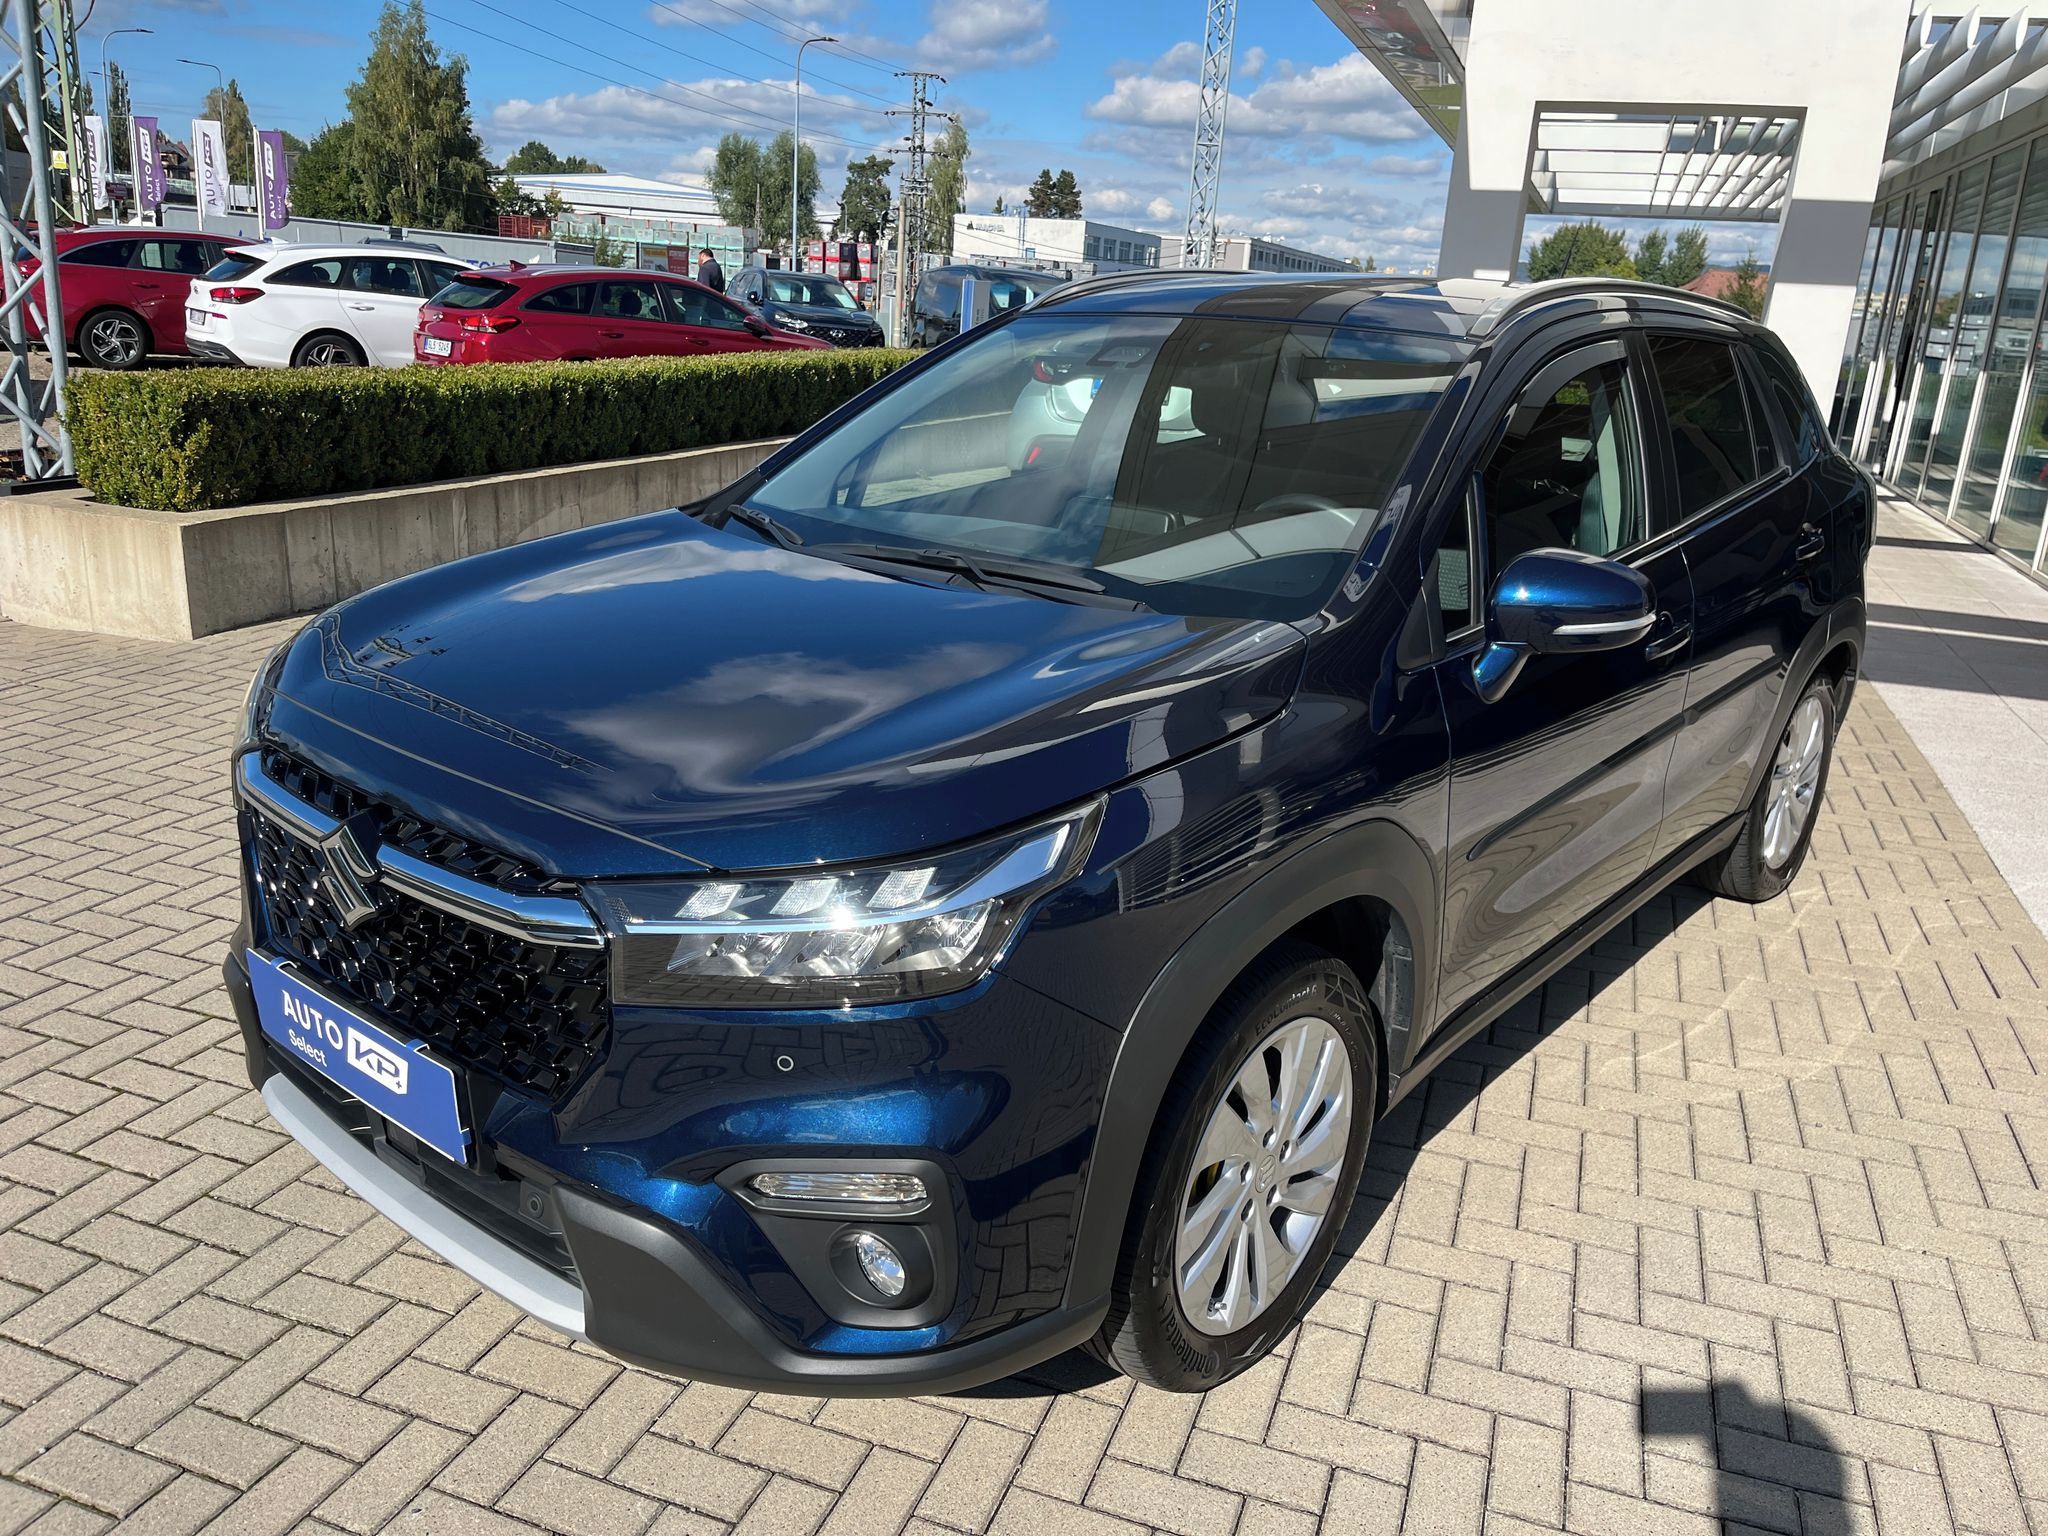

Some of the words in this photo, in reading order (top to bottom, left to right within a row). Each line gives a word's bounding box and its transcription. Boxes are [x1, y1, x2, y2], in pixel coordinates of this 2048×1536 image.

[145, 164, 154, 202] AUTO
[204, 169, 217, 206] AUTO
[268, 180, 277, 219] AUTO
[282, 989, 344, 1050] AUTO
[288, 1028, 328, 1068] Select
